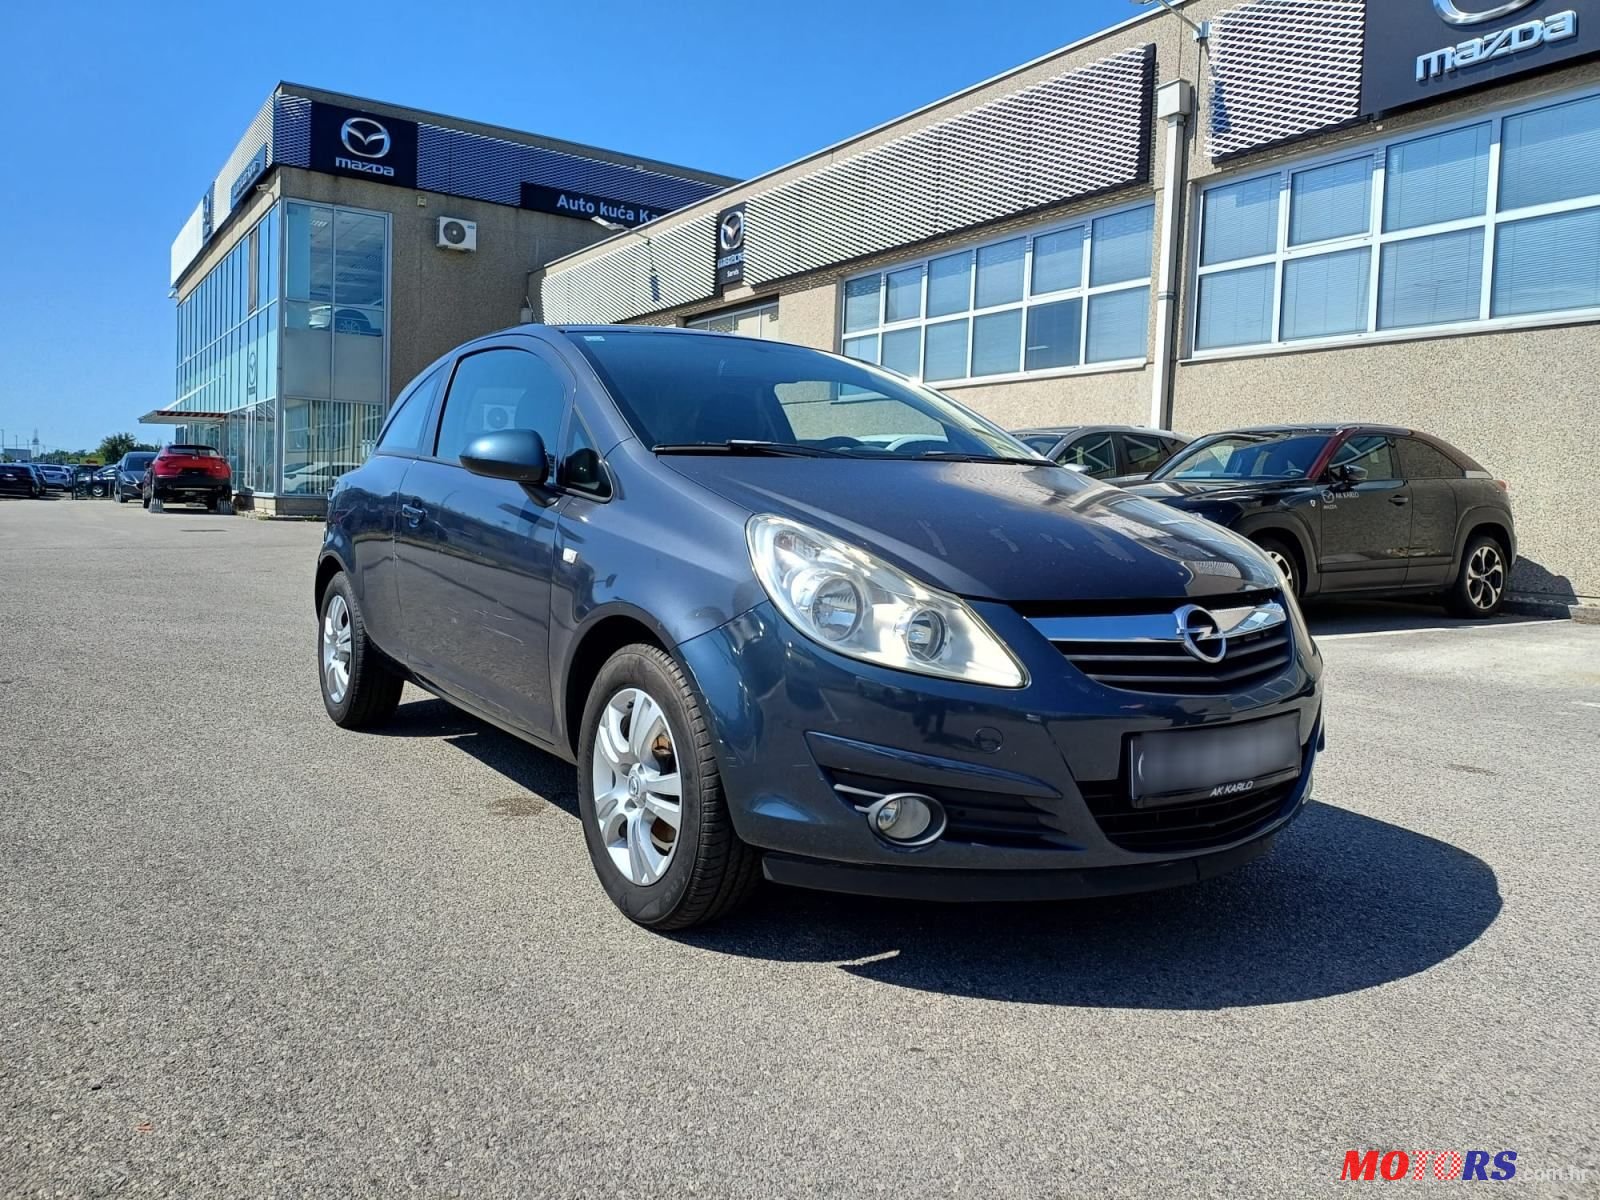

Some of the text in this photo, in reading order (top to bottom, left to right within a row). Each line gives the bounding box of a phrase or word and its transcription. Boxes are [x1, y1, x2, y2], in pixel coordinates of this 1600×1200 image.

[1415, 9, 1577, 82] mazda
[335, 156, 394, 177] mazda
[556, 194, 596, 214] Auto
[600, 201, 635, 221] kuća
[1209, 780, 1254, 797] AK KARLO
